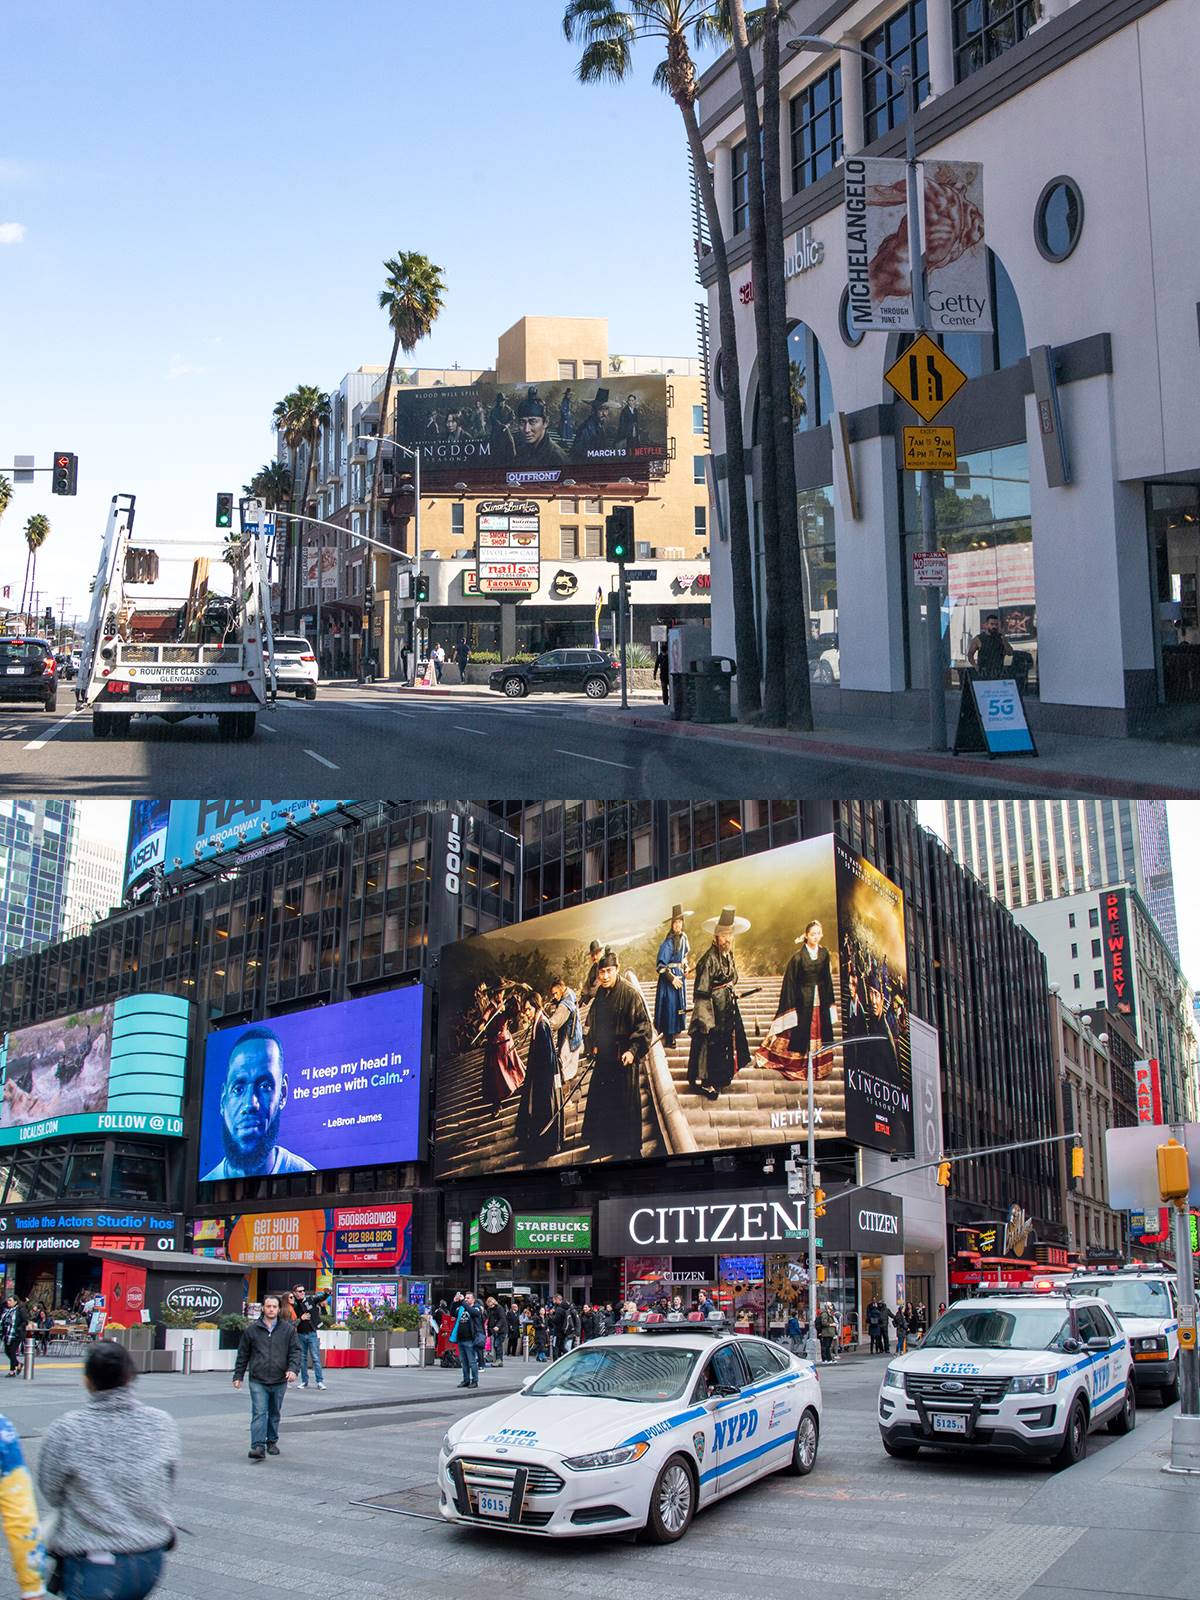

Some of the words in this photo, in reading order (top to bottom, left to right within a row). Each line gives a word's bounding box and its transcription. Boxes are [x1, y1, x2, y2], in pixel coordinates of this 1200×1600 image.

[845, 159, 873, 323] MICHELANGELO
[784, 228, 819, 278] ublic
[880, 307, 910, 315] THROUGH
[927, 290, 986, 318] Getty
[881, 315, 897, 324] JUNE
[940, 314, 977, 326] Center
[587, 449, 615, 457] MARCH
[617, 448, 626, 456] 13
[508, 472, 557, 481] OUTFRONT
[488, 563, 527, 574] nails
[913, 558, 924, 569] NO
[140, 668, 179, 676] ROUNTREE
[180, 668, 204, 676] GLASS
[989, 699, 1014, 716] 5G
[195, 838, 209, 850] ON
[210, 817, 260, 844] BROADWAY
[445, 813, 461, 895] 1500
[1106, 893, 1124, 998] BREWERY
[312, 1064, 339, 1080] keep
[340, 1061, 358, 1074] my
[360, 1053, 389, 1071] head
[391, 1052, 402, 1065] in
[293, 1086, 310, 1100] the
[312, 1082, 342, 1099] game
[344, 1077, 368, 1091] with
[848, 1068, 910, 1113] KINGDOM
[1137, 1068, 1151, 1122] PARK
[98, 1115, 147, 1129] FOLLOW
[327, 1115, 356, 1128] LeBron
[356, 1112, 383, 1124] James
[771, 1107, 823, 1129] NETFLX
[41, 1216, 56, 1228] the
[57, 1215, 94, 1228] Actors
[97, 1215, 147, 1229] Studio'
[254, 1219, 271, 1235] GET
[273, 1217, 300, 1234] YOUR
[516, 1221, 590, 1232] STARBUCKS
[629, 1201, 806, 1245] CITIZEN
[858, 1209, 899, 1235] CITIZEN
[6, 1238, 22, 1250] fans
[23, 1238, 36, 1250] for
[36, 1236, 81, 1251] patience
[253, 1235, 284, 1251] RETAIL
[286, 1234, 300, 1250] ON
[348, 1231, 360, 1243] 212
[360, 1231, 375, 1242] 984
[375, 1230, 393, 1242] 8126
[528, 1233, 575, 1243] COFFEE
[663, 1271, 705, 1282] CITIZEN
[171, 1294, 220, 1307] STRAND
[932, 1366, 980, 1375] POLICE
[646, 1419, 673, 1438] POLICE
[712, 1408, 759, 1454] NYPD
[936, 1419, 957, 1429] 5125
[499, 1428, 537, 1438] NYPD
[484, 1434, 541, 1448] POLICE
[481, 1496, 505, 1513] 3615
